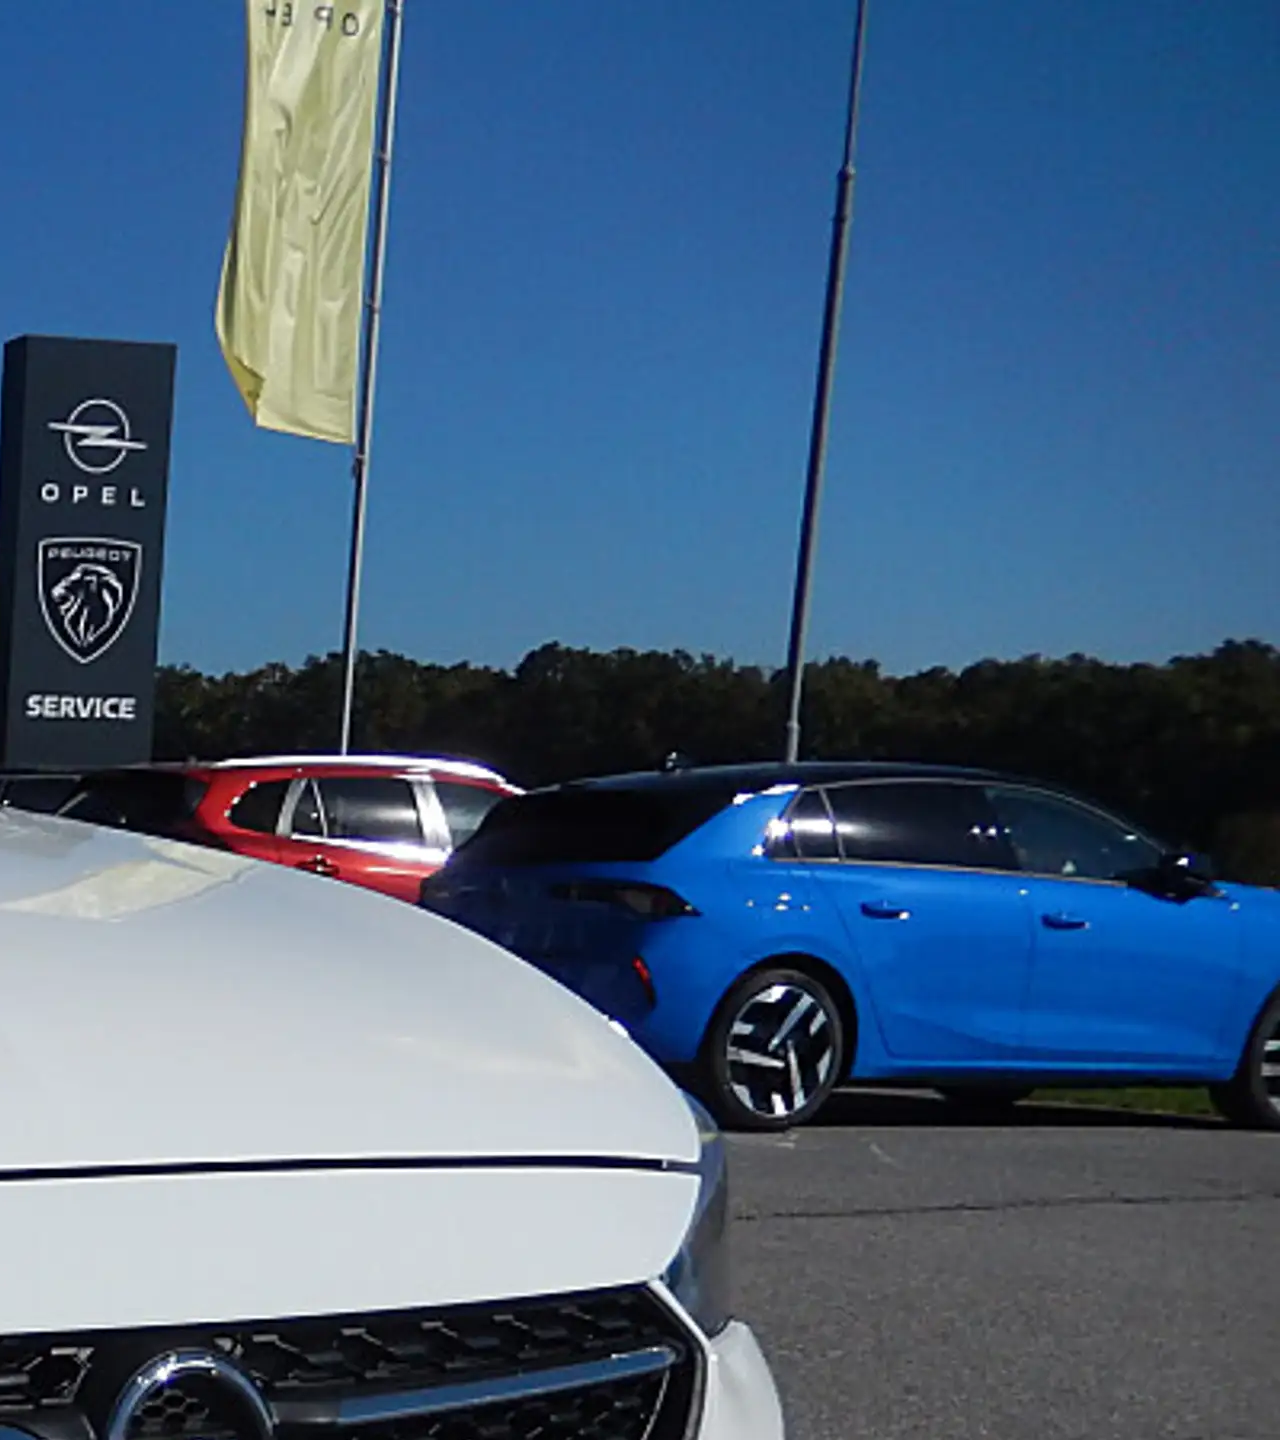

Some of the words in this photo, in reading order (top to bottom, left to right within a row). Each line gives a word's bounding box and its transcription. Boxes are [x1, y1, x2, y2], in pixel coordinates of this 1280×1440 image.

[41, 482, 146, 507] OPEL
[47, 547, 132, 561] PEUGEOT
[26, 694, 137, 719] SERVICE
